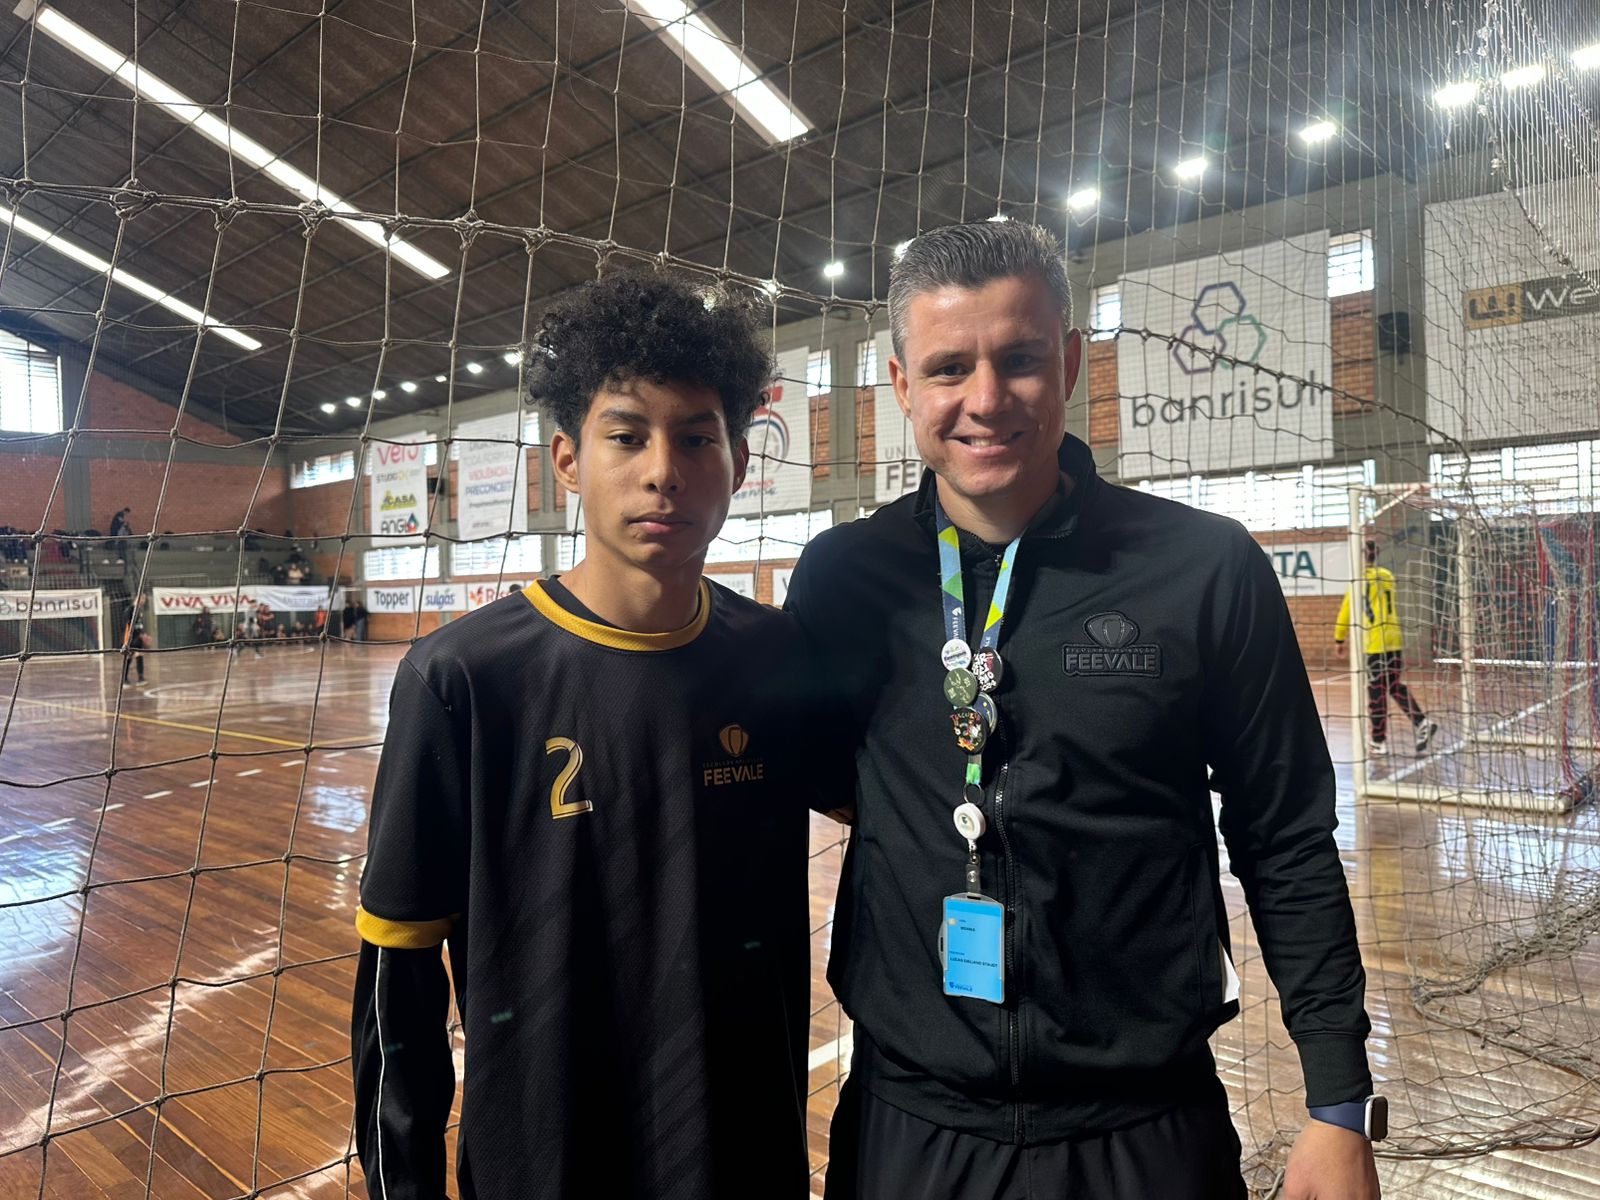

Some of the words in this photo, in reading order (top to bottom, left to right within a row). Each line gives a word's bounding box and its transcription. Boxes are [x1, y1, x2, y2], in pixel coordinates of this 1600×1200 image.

[1132, 370, 1315, 428] banrisul
[16, 596, 98, 613] banrisul
[160, 596, 205, 609] VIVA
[210, 594, 252, 607] VIVA
[375, 590, 410, 610] Topper
[1065, 653, 1156, 671] FEEVALE
[545, 736, 593, 820] 2
[704, 763, 764, 787] FEEVALE
